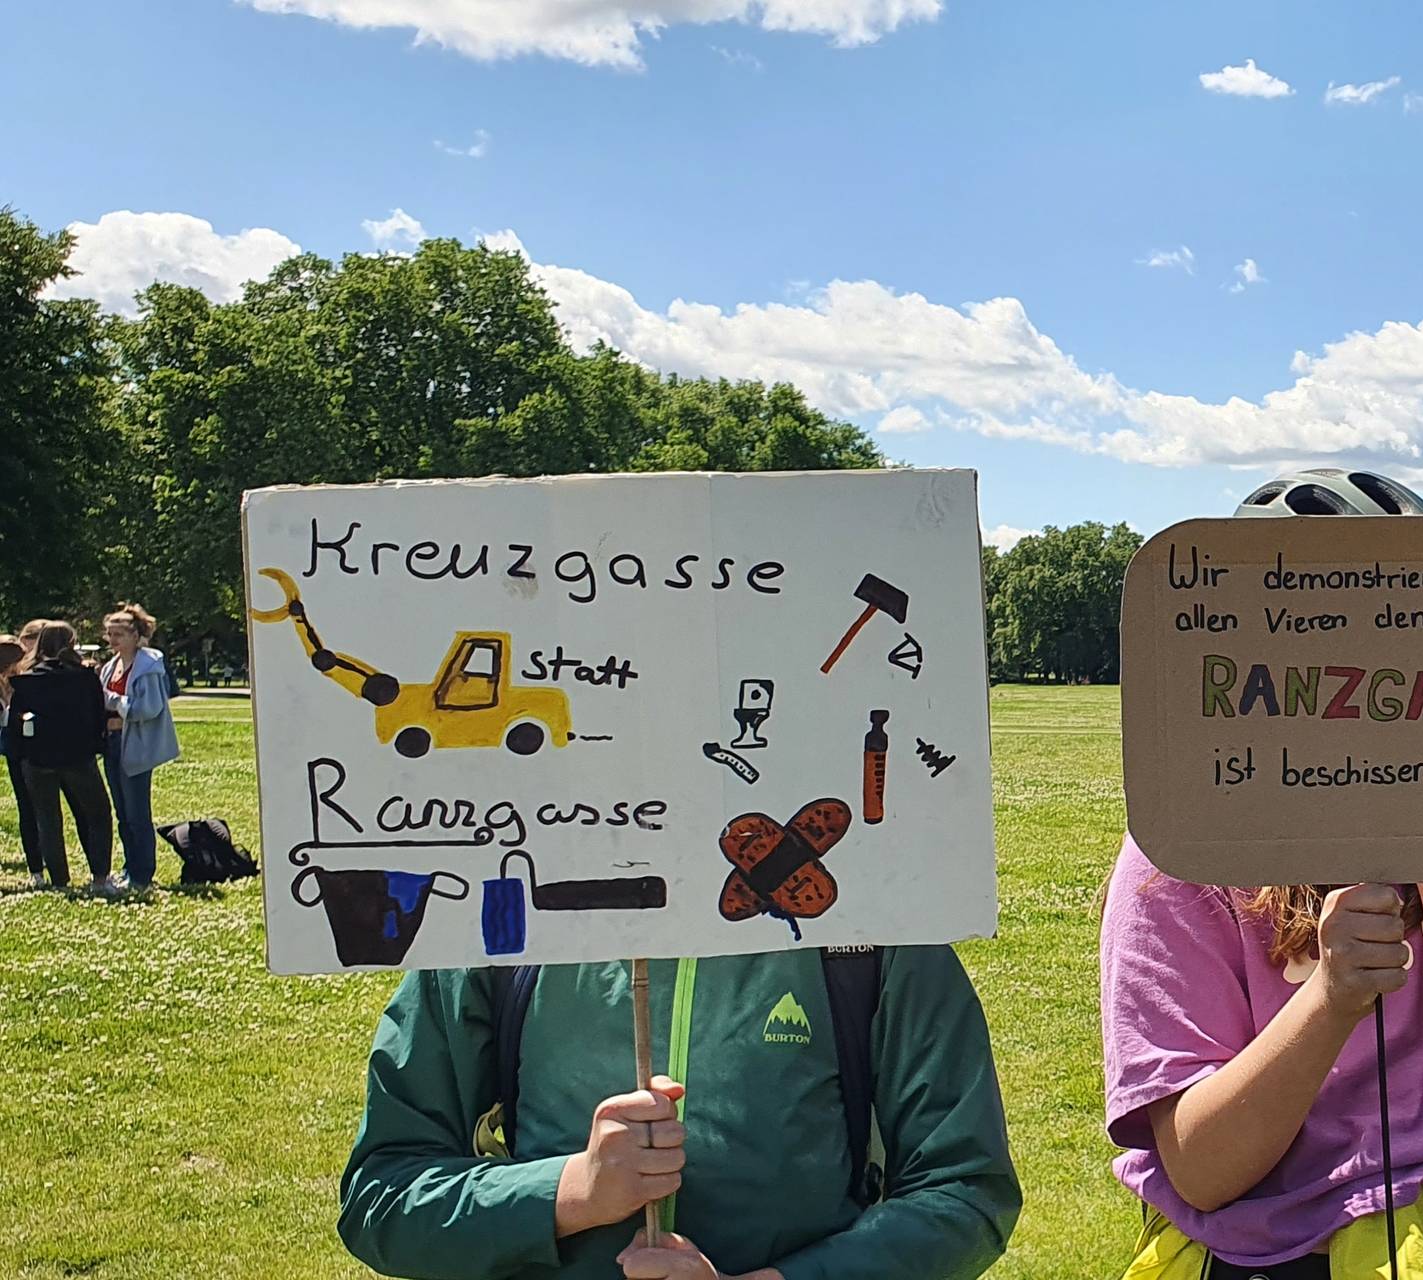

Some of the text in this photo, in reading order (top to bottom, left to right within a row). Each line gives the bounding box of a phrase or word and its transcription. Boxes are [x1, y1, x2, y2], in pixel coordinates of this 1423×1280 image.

[302, 517, 786, 603] Kreuzgasse
[1168, 542, 1229, 591] Wir
[1175, 603, 1239, 634] allen
[1264, 607, 1348, 634] Vieren
[1214, 746, 1256, 786] ist
[826, 944, 875, 954] BURTON
[763, 1032, 811, 1046] BURTON
